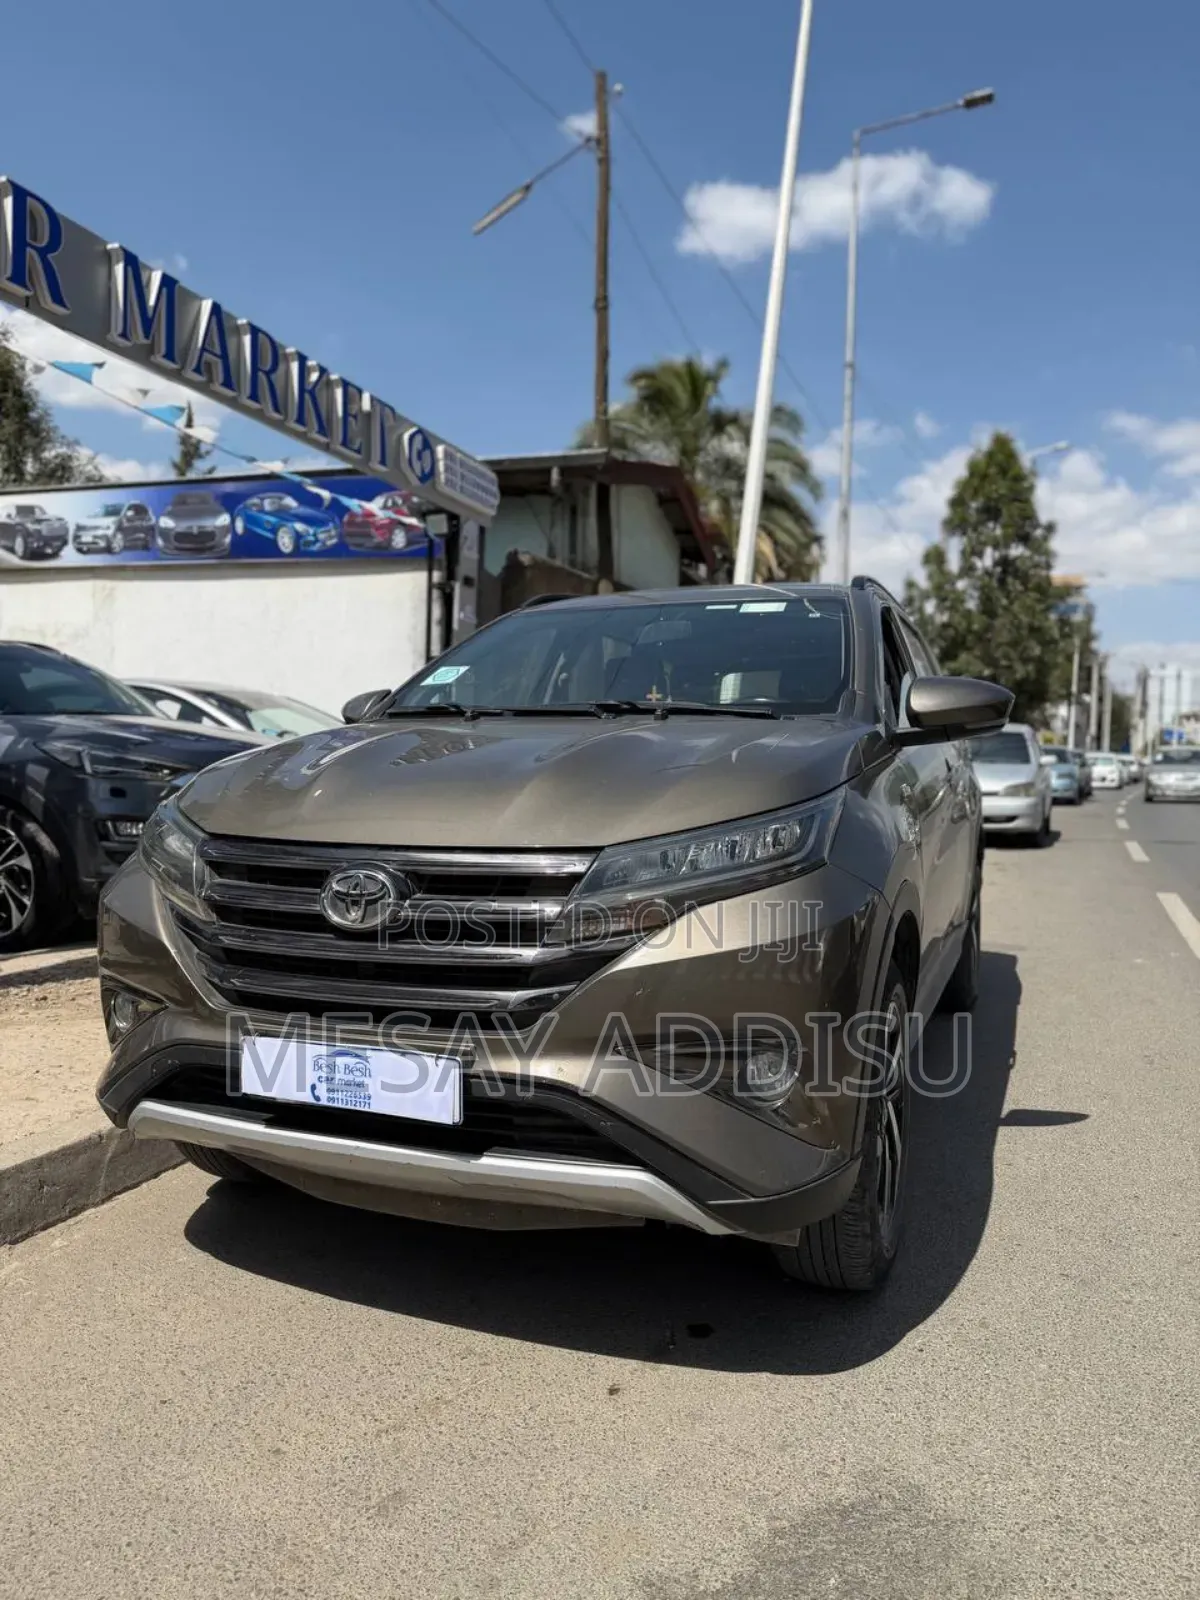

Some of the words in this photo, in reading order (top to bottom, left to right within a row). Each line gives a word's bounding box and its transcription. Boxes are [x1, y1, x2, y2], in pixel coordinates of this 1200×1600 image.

[0, 177, 71, 315] R
[107, 242, 396, 471] MARKET
[313, 1058, 340, 1074] Besh
[344, 1062, 371, 1078] Besh
